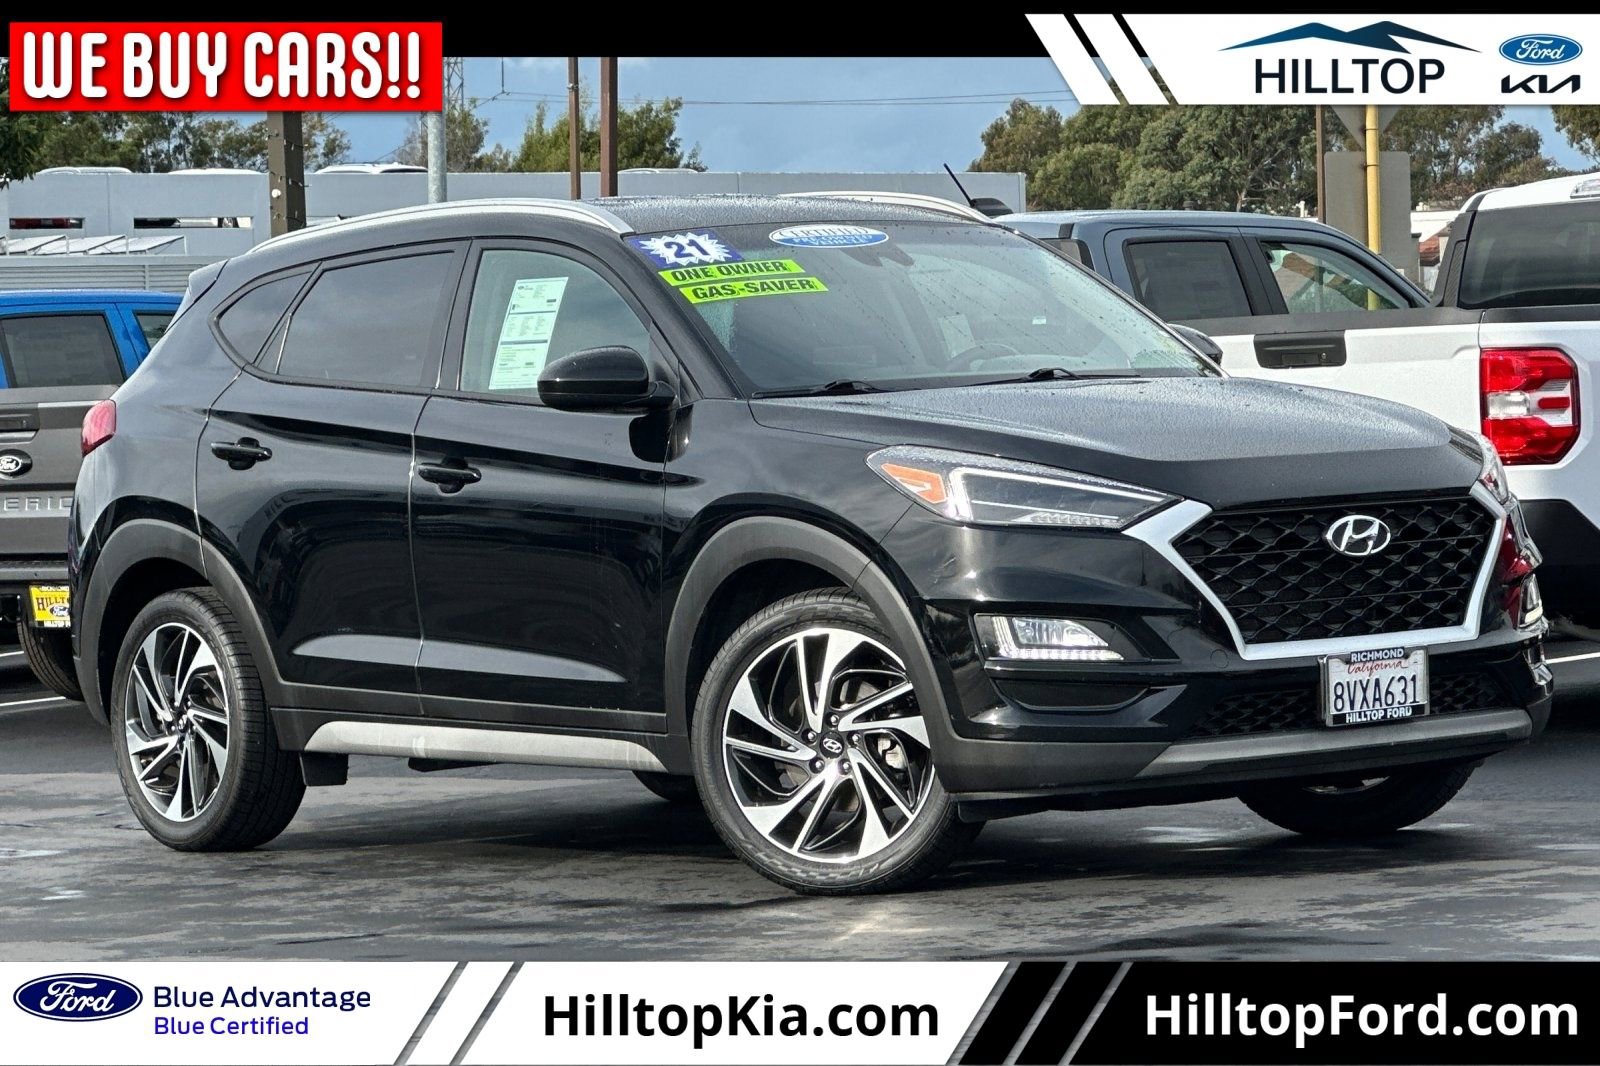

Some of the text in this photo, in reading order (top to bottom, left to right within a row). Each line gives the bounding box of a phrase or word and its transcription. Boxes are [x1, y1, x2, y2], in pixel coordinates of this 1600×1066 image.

[663, 238, 711, 259] 21
[671, 260, 787, 282] ONE OWNER
[1351, 648, 1404, 662] RICHMOND
[1348, 660, 1408, 677] California
[1333, 674, 1420, 712] 8VXA631
[1345, 706, 1412, 723] HILLTOP FORD
